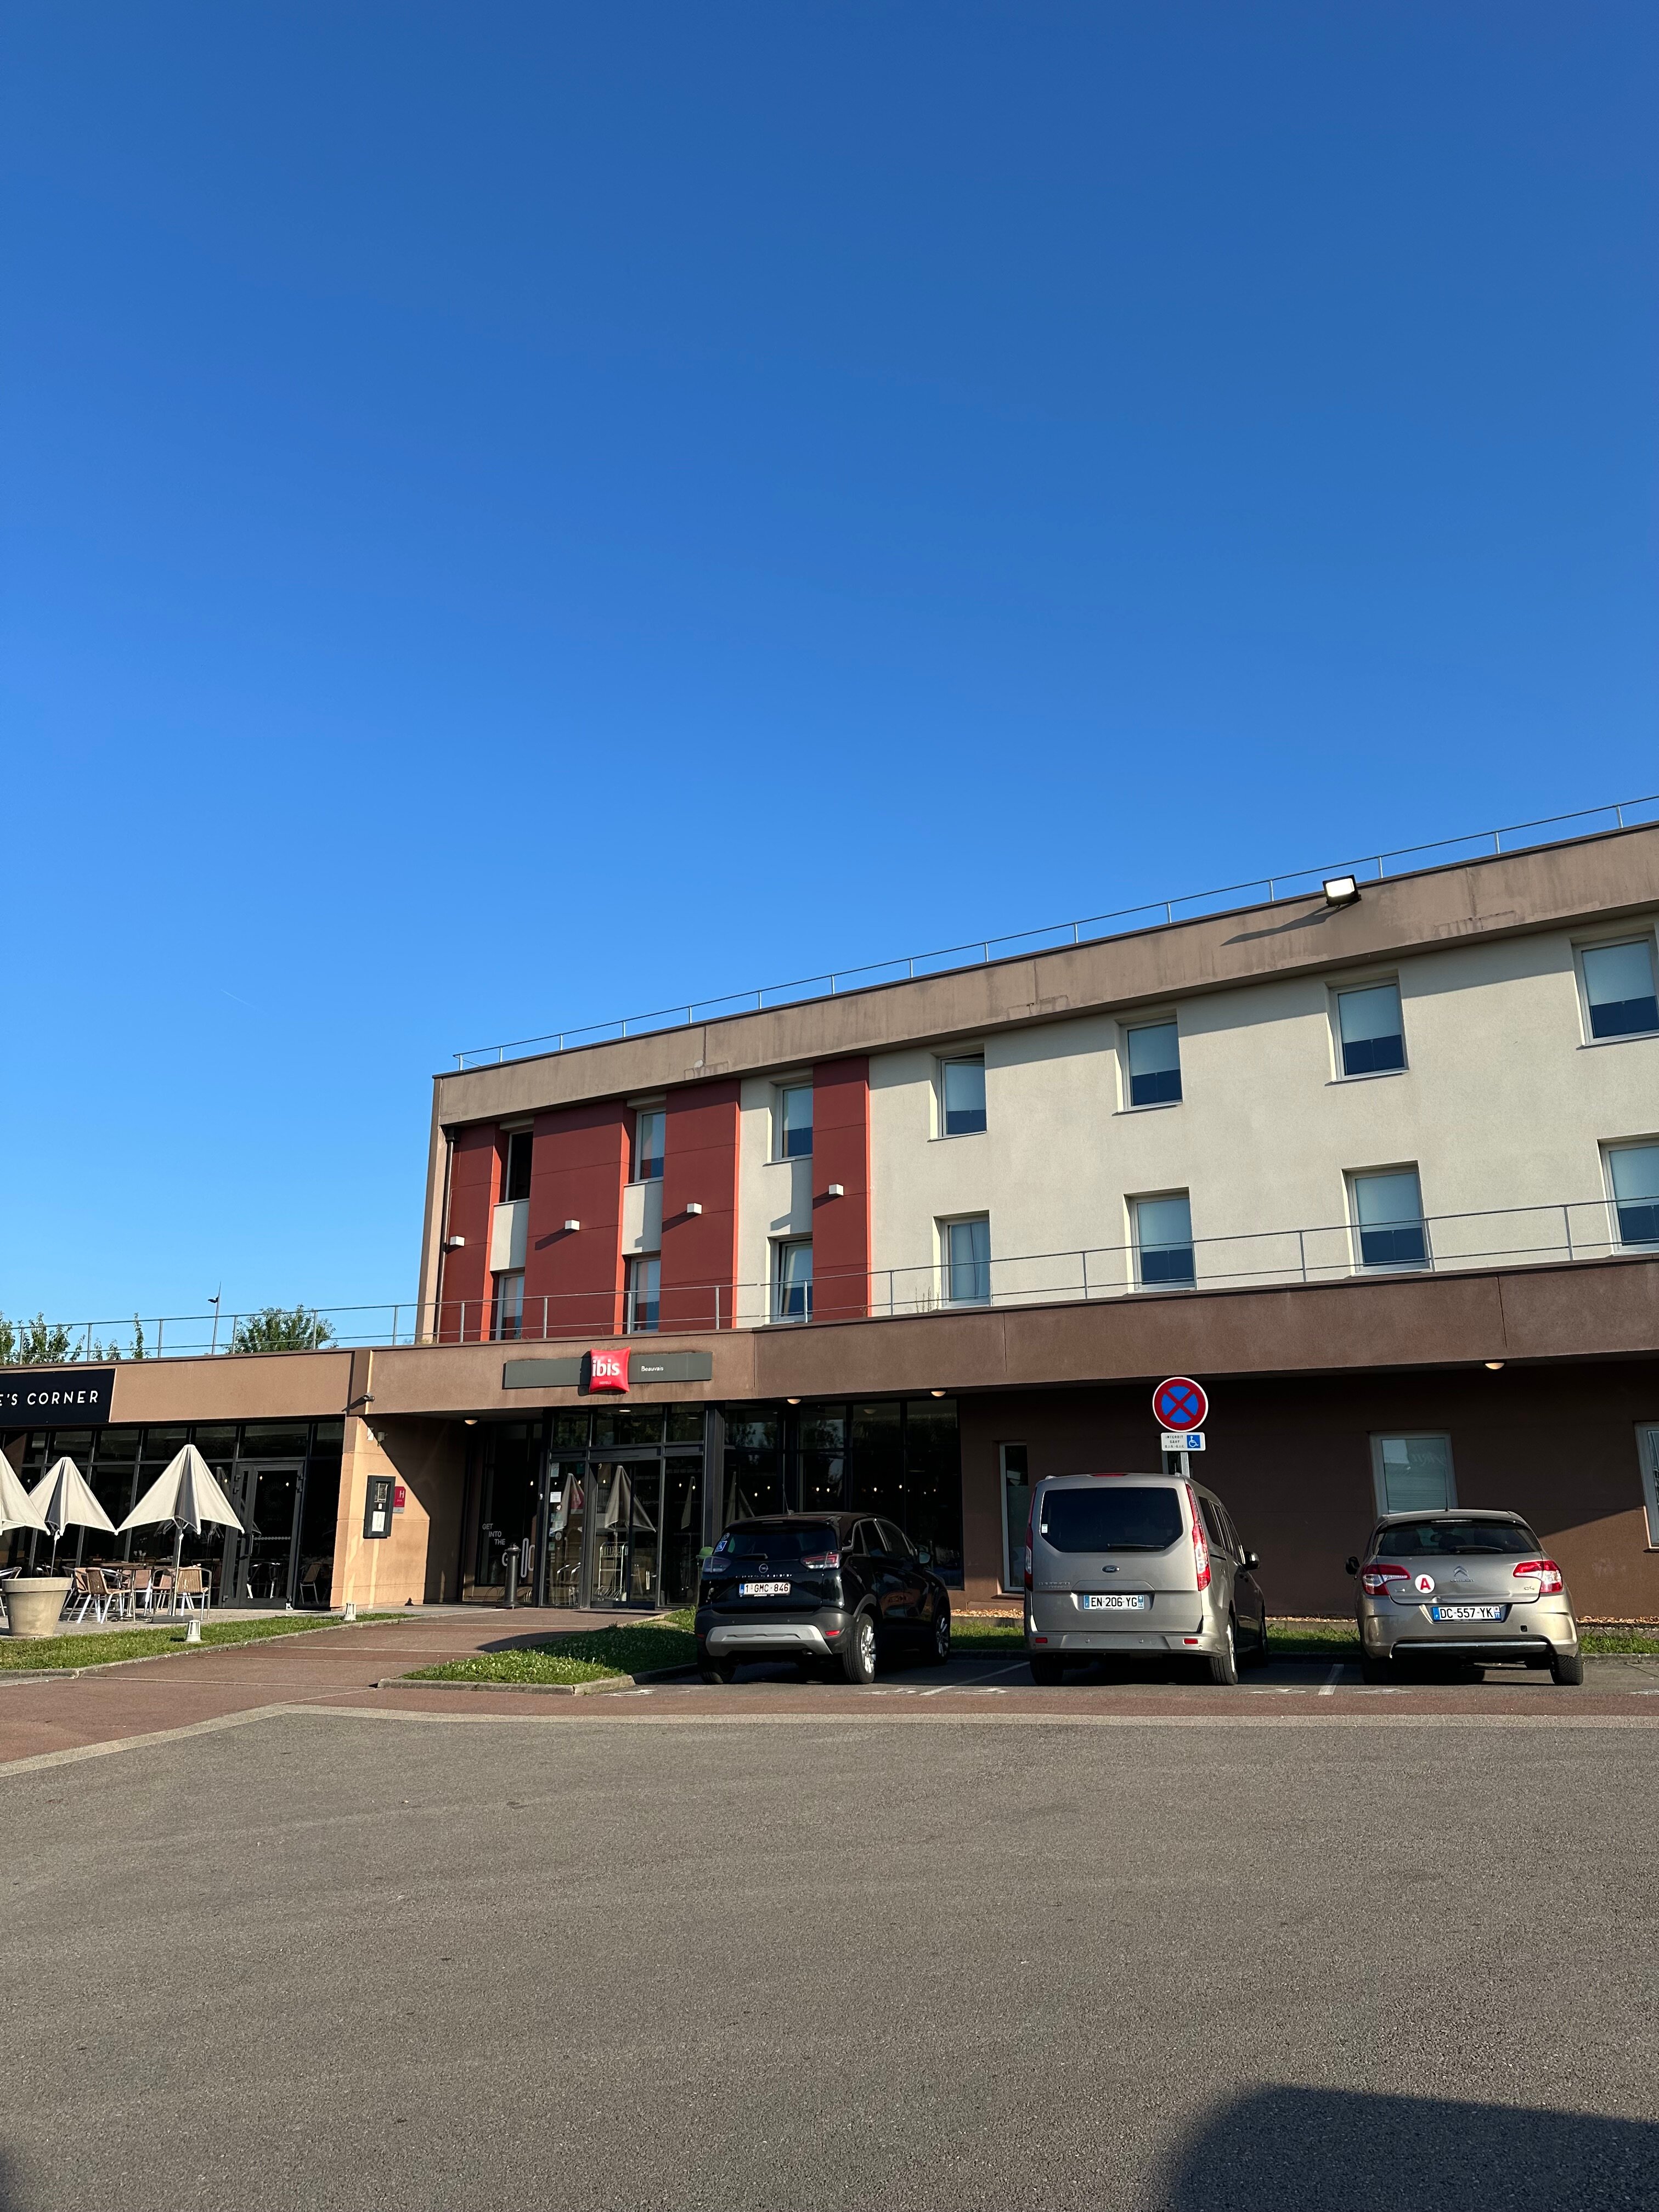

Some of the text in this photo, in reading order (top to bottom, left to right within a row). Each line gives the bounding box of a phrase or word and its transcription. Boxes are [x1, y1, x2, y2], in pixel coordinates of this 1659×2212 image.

[592, 1358, 620, 1377] ibis
[27, 1390, 98, 1405] CORNER
[399, 1490, 405, 1498] H
[1420, 1578, 1431, 1590] A
